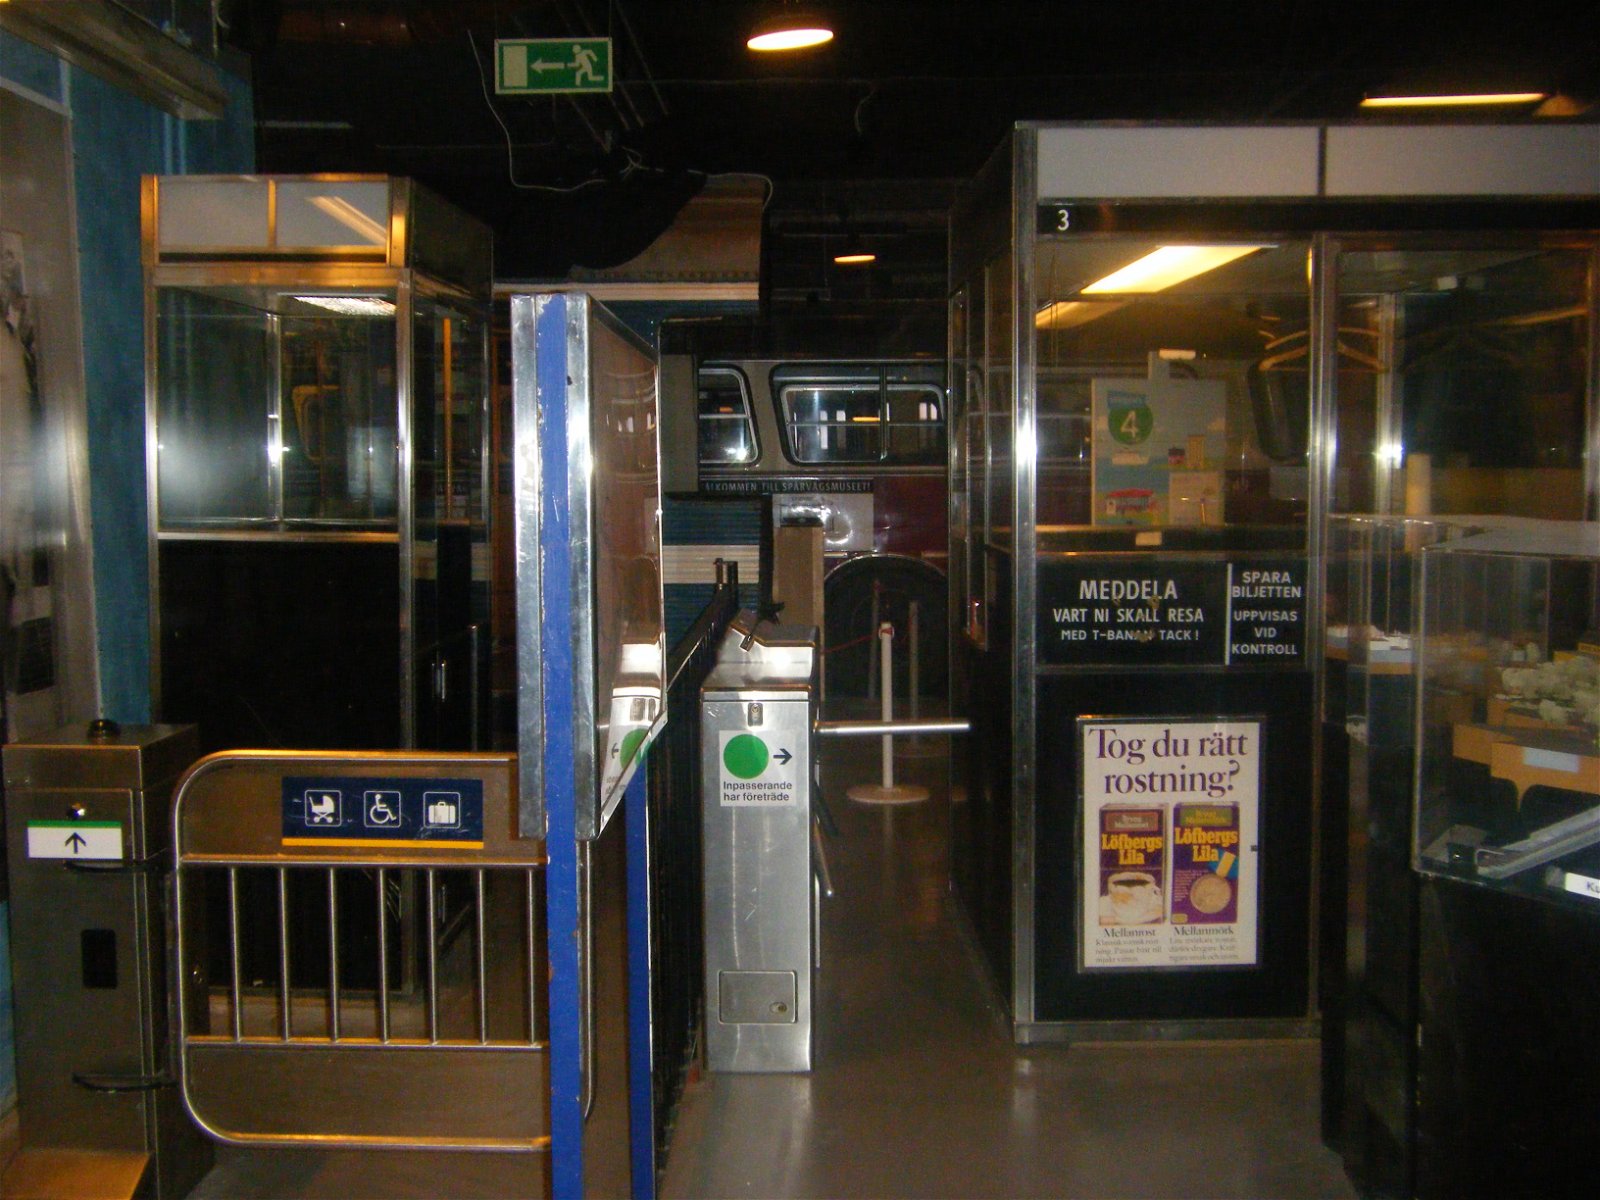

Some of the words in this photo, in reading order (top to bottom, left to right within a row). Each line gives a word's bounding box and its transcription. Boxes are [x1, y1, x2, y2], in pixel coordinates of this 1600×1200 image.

[1057, 208, 1071, 232] 3
[1119, 410, 1139, 439] 4
[1241, 571, 1292, 584] SPARA
[1079, 579, 1179, 600] MEDDELA
[1231, 585, 1302, 599] BILJETTEN
[1052, 607, 1088, 623] VART
[1094, 608, 1109, 623] NI
[1116, 607, 1160, 623] SKALL
[1167, 607, 1205, 623] RESA
[1233, 610, 1298, 622] UPPVISAS
[1060, 629, 1087, 641] MED
[1254, 627, 1277, 639] VID
[1231, 643, 1297, 655] KONTROLL
[1088, 727, 1147, 766] Tog
[1152, 728, 1190, 757] du
[1199, 731, 1249, 757] rätt
[722, 780, 793, 792] Inpasserande
[1104, 760, 1240, 798] rostning?
[723, 792, 740, 802] har
[742, 791, 790, 802] företräde
[1101, 833, 1163, 853] Löfbergs
[1174, 827, 1239, 848] Löfbergs
[1118, 849, 1146, 865] Lila
[1192, 844, 1220, 862] Lila
